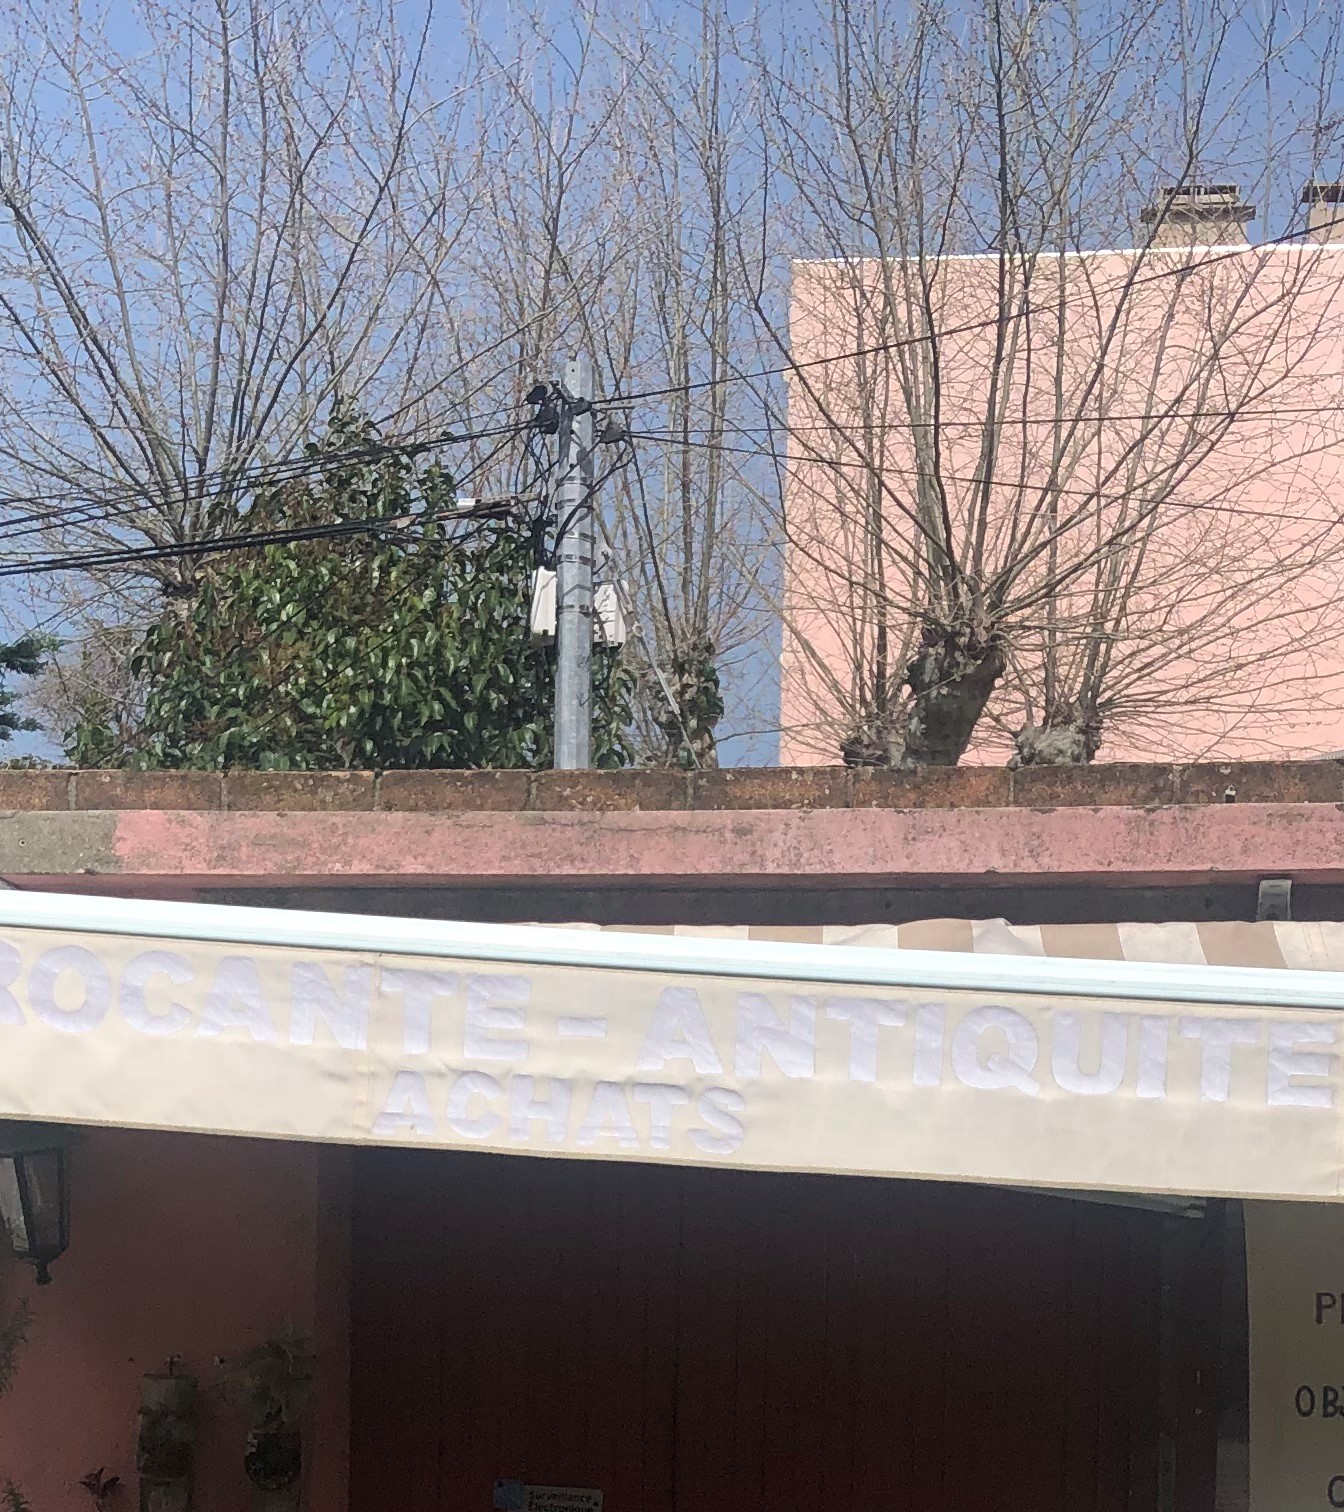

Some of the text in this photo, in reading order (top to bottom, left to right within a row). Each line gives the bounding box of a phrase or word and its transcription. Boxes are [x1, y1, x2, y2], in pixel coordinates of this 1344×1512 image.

[637, 985, 1338, 1109] ANTIQUITE
[372, 1069, 747, 1155] ACHATS
[528, 1490, 592, 1504] Surveillance
